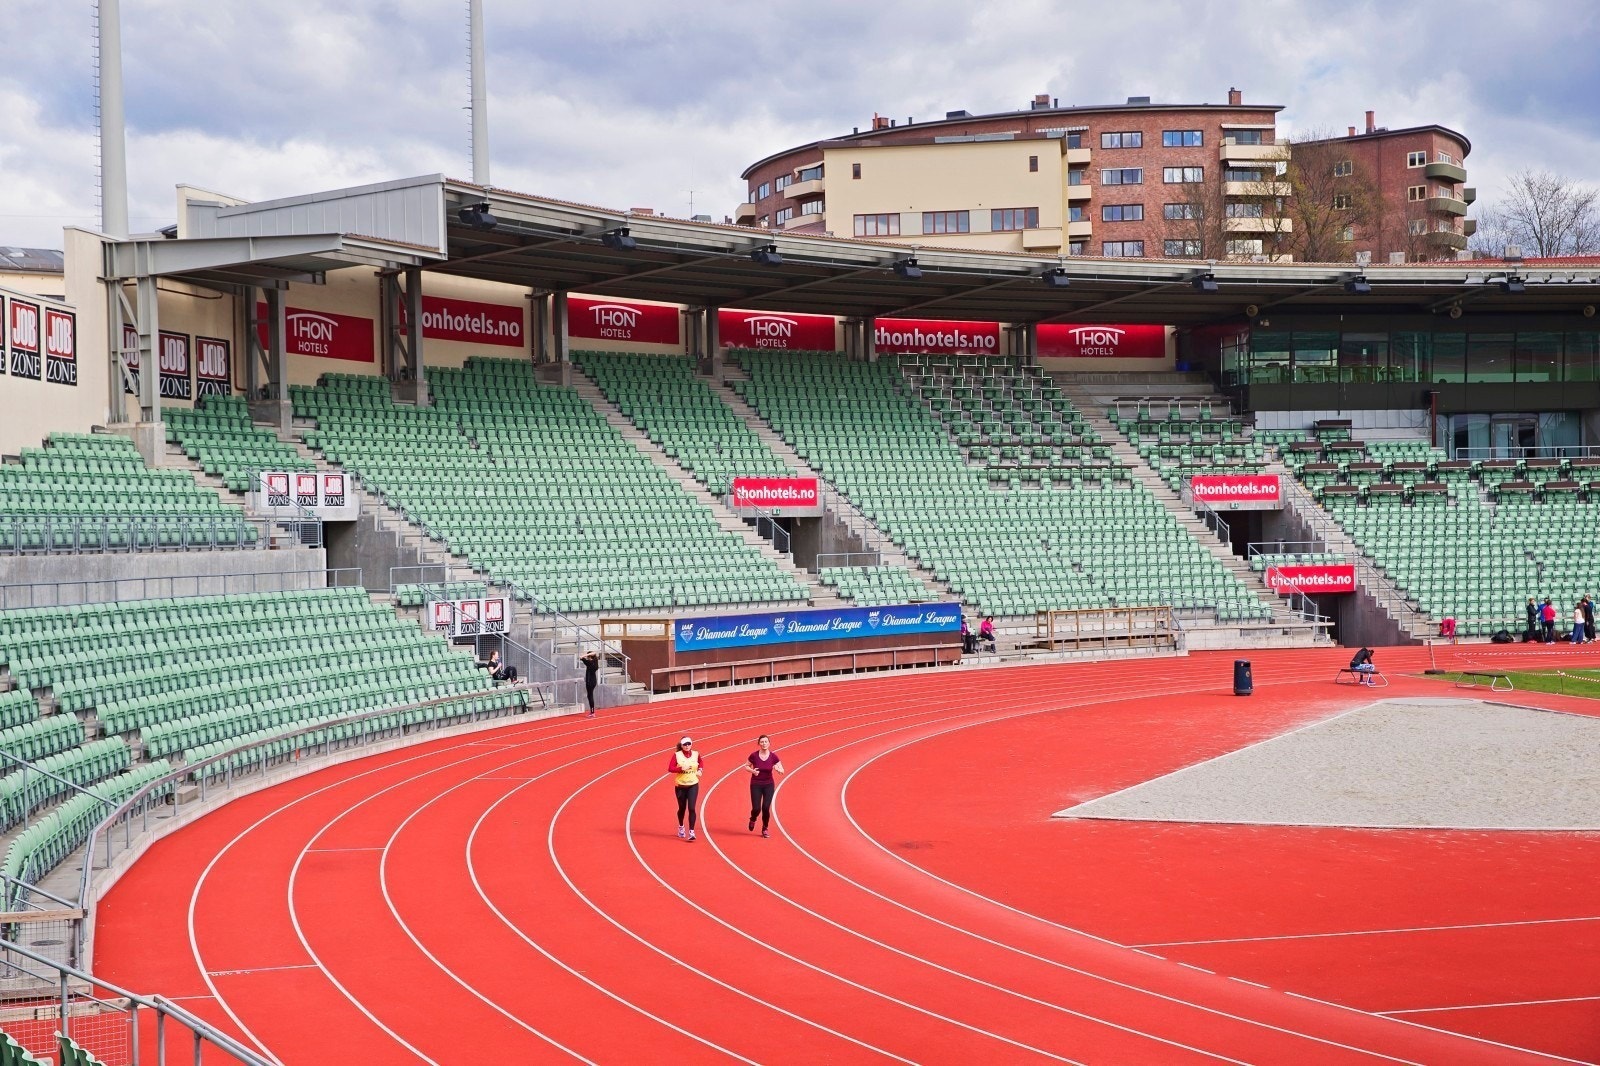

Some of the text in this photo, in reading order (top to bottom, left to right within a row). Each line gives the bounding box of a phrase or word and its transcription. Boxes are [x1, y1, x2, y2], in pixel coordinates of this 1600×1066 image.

[403, 307, 520, 337] onhotels.no
[588, 304, 642, 328] THON
[13, 307, 36, 347] JOB
[48, 315, 72, 354] JOB
[287, 313, 339, 342] THON
[600, 328, 632, 339] HOTELS
[743, 315, 798, 337] THON
[755, 338, 787, 348] HOTELS
[874, 326, 996, 348] thonhotels.no
[1068, 326, 1126, 345] THON
[124, 331, 140, 366] JO
[161, 337, 186, 372] JOB
[298, 341, 329, 354] HOTELS
[1081, 347, 1114, 355] HOTELS
[11, 352, 40, 377] ZONE
[199, 343, 226, 377] JOB
[47, 359, 77, 383] ZONE
[160, 377, 191, 398] ZONE
[268, 476, 288, 493] JOB
[298, 477, 316, 493] JOB
[325, 477, 342, 494] JOB
[736, 486, 815, 499] thonhotels.no
[1195, 482, 1277, 495] thonhotels.no
[268, 496, 290, 505] ZONE
[296, 496, 318, 505] ZONE
[324, 496, 345, 505] ZONE
[486, 602, 501, 619] JOB
[881, 611, 957, 627] Diamond League
[695, 624, 769, 641] Diamond League
[786, 617, 863, 634] Diamond League
